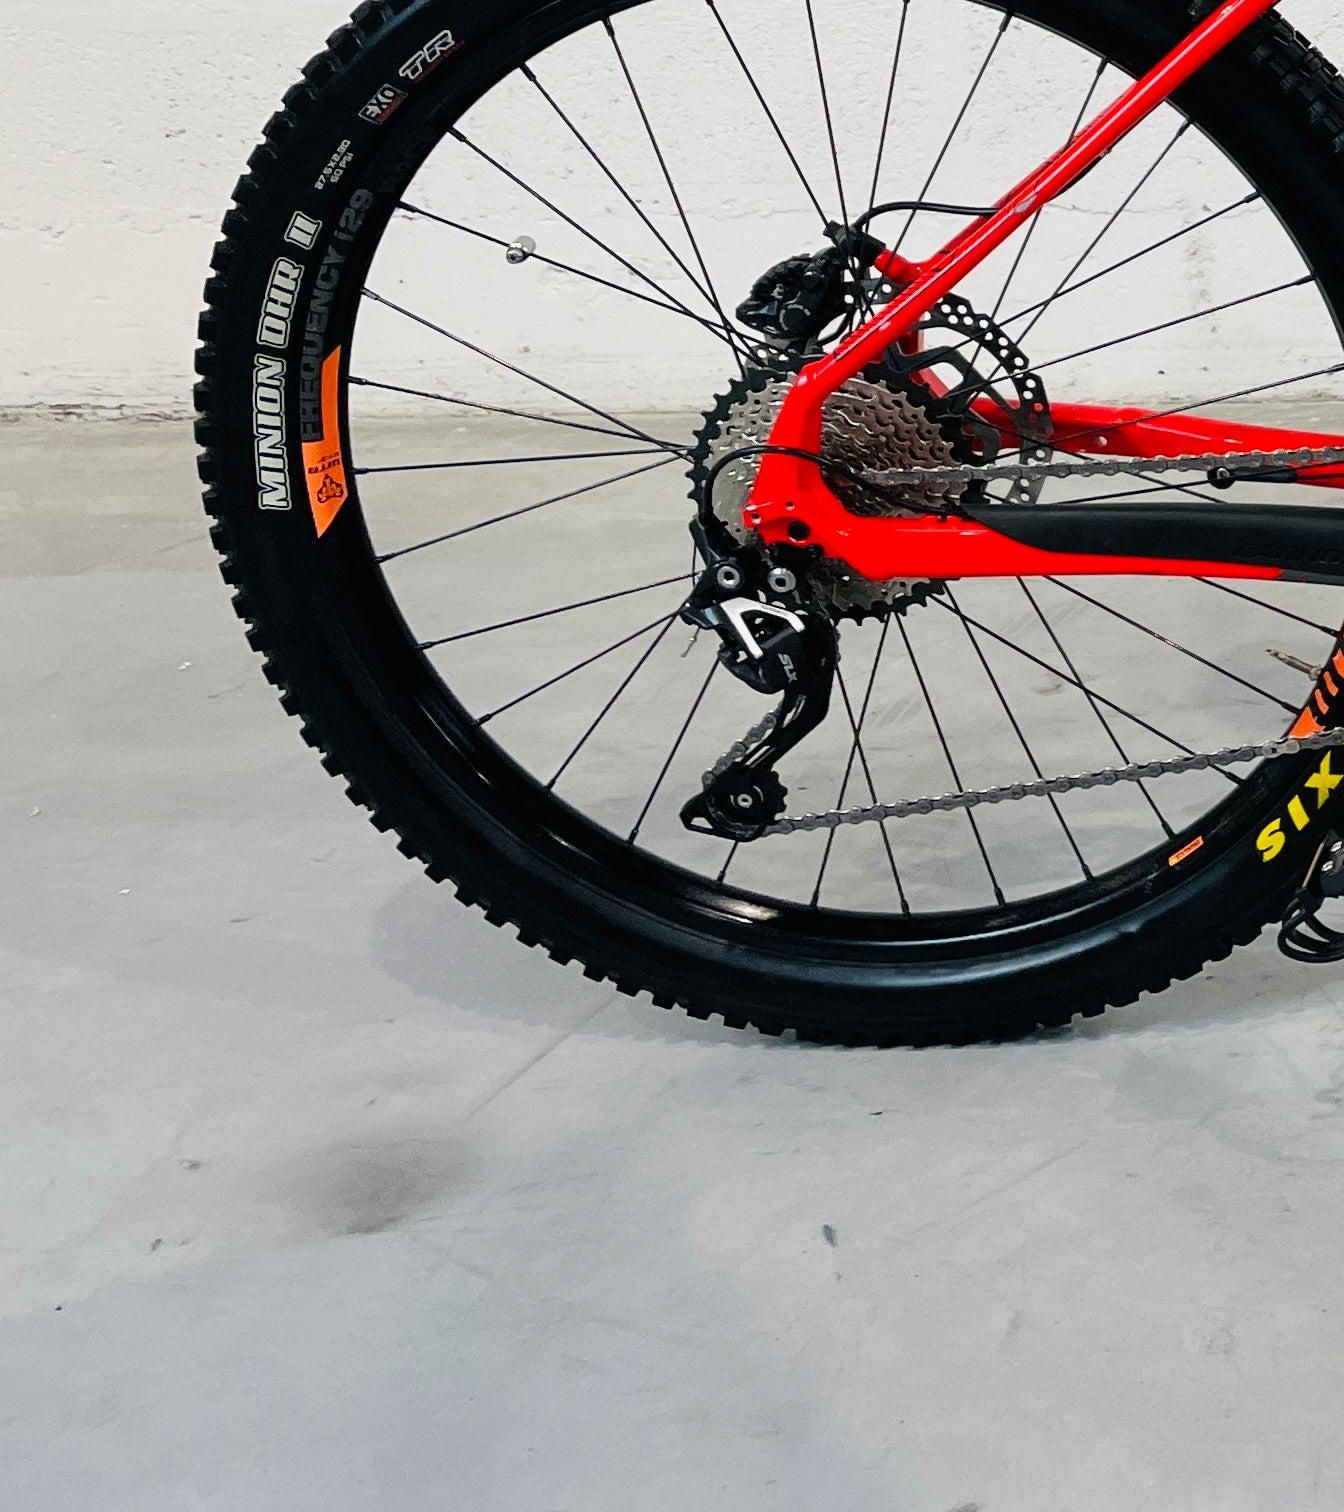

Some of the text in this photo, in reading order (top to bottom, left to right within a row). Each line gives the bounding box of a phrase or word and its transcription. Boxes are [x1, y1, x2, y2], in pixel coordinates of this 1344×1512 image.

[399, 29, 455, 80] TR
[256, 256, 305, 348] DHR
[301, 244, 346, 438] FREQUENCY
[254, 353, 293, 512] MINION
